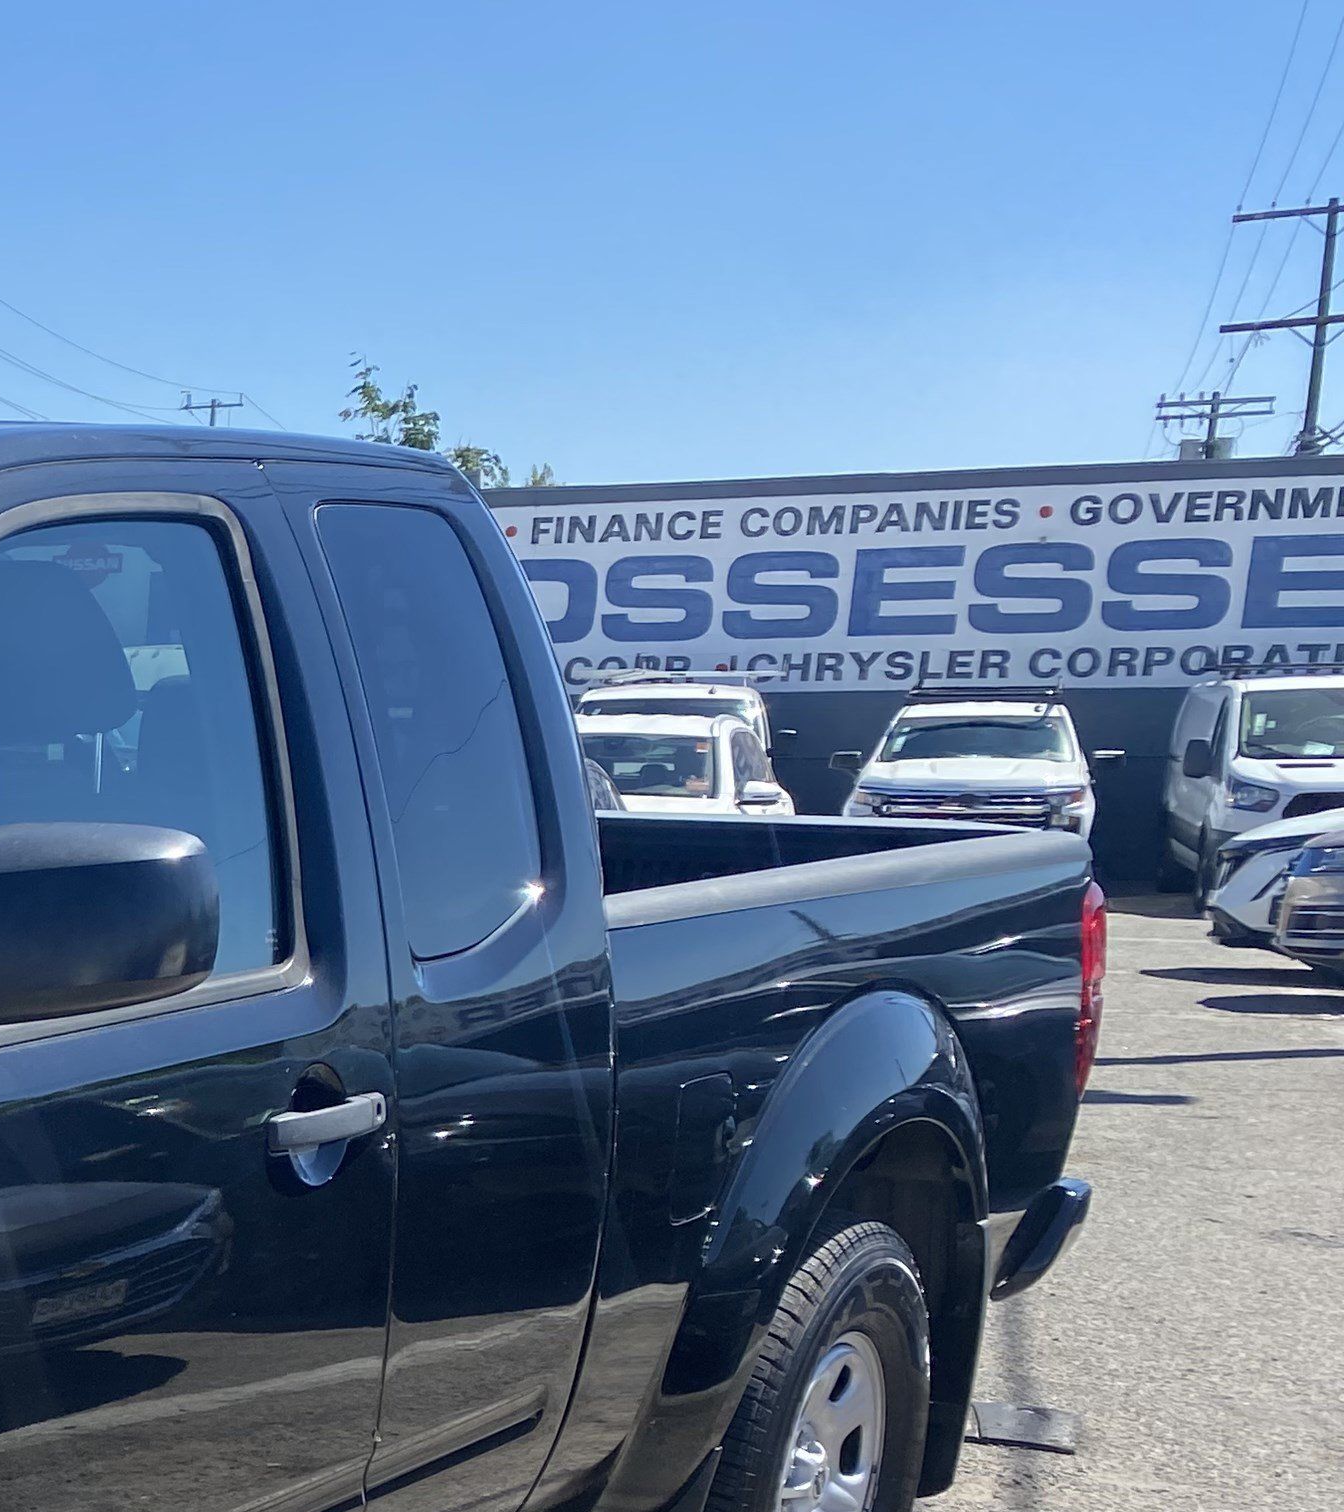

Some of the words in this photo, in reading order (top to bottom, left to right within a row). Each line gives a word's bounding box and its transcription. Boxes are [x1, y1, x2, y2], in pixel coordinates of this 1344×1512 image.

[530, 509, 724, 545] FINANCE
[740, 498, 1021, 538] COMPANIES
[754, 649, 1012, 683] CHRYSLER
